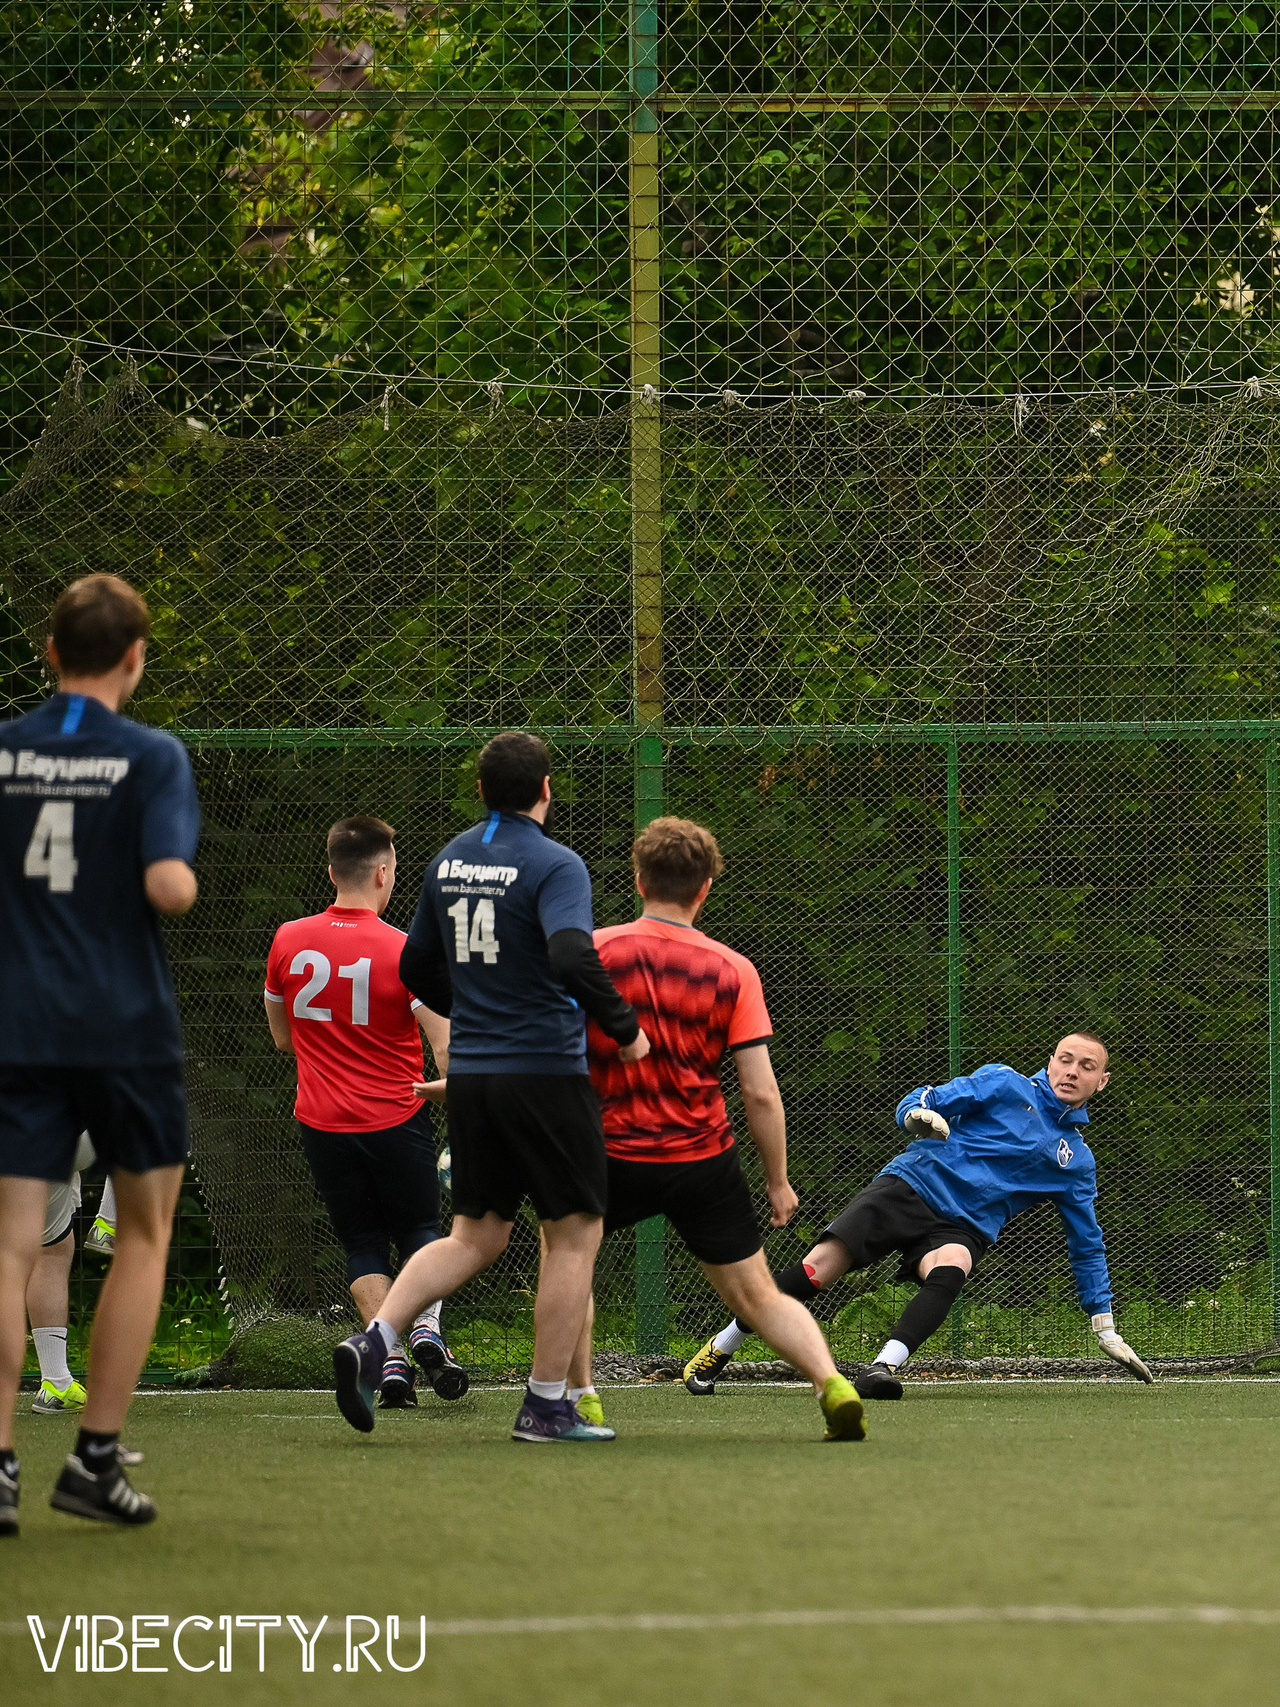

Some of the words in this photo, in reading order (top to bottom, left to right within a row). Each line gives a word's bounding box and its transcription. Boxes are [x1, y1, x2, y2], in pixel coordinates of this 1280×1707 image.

[15, 749, 129, 785] Бауцентр
[24, 801, 78, 892] 4
[449, 859, 518, 886] Бауцентр
[447, 897, 500, 964] 14
[289, 949, 372, 1026] 21
[520, 1415, 534, 1429] 10
